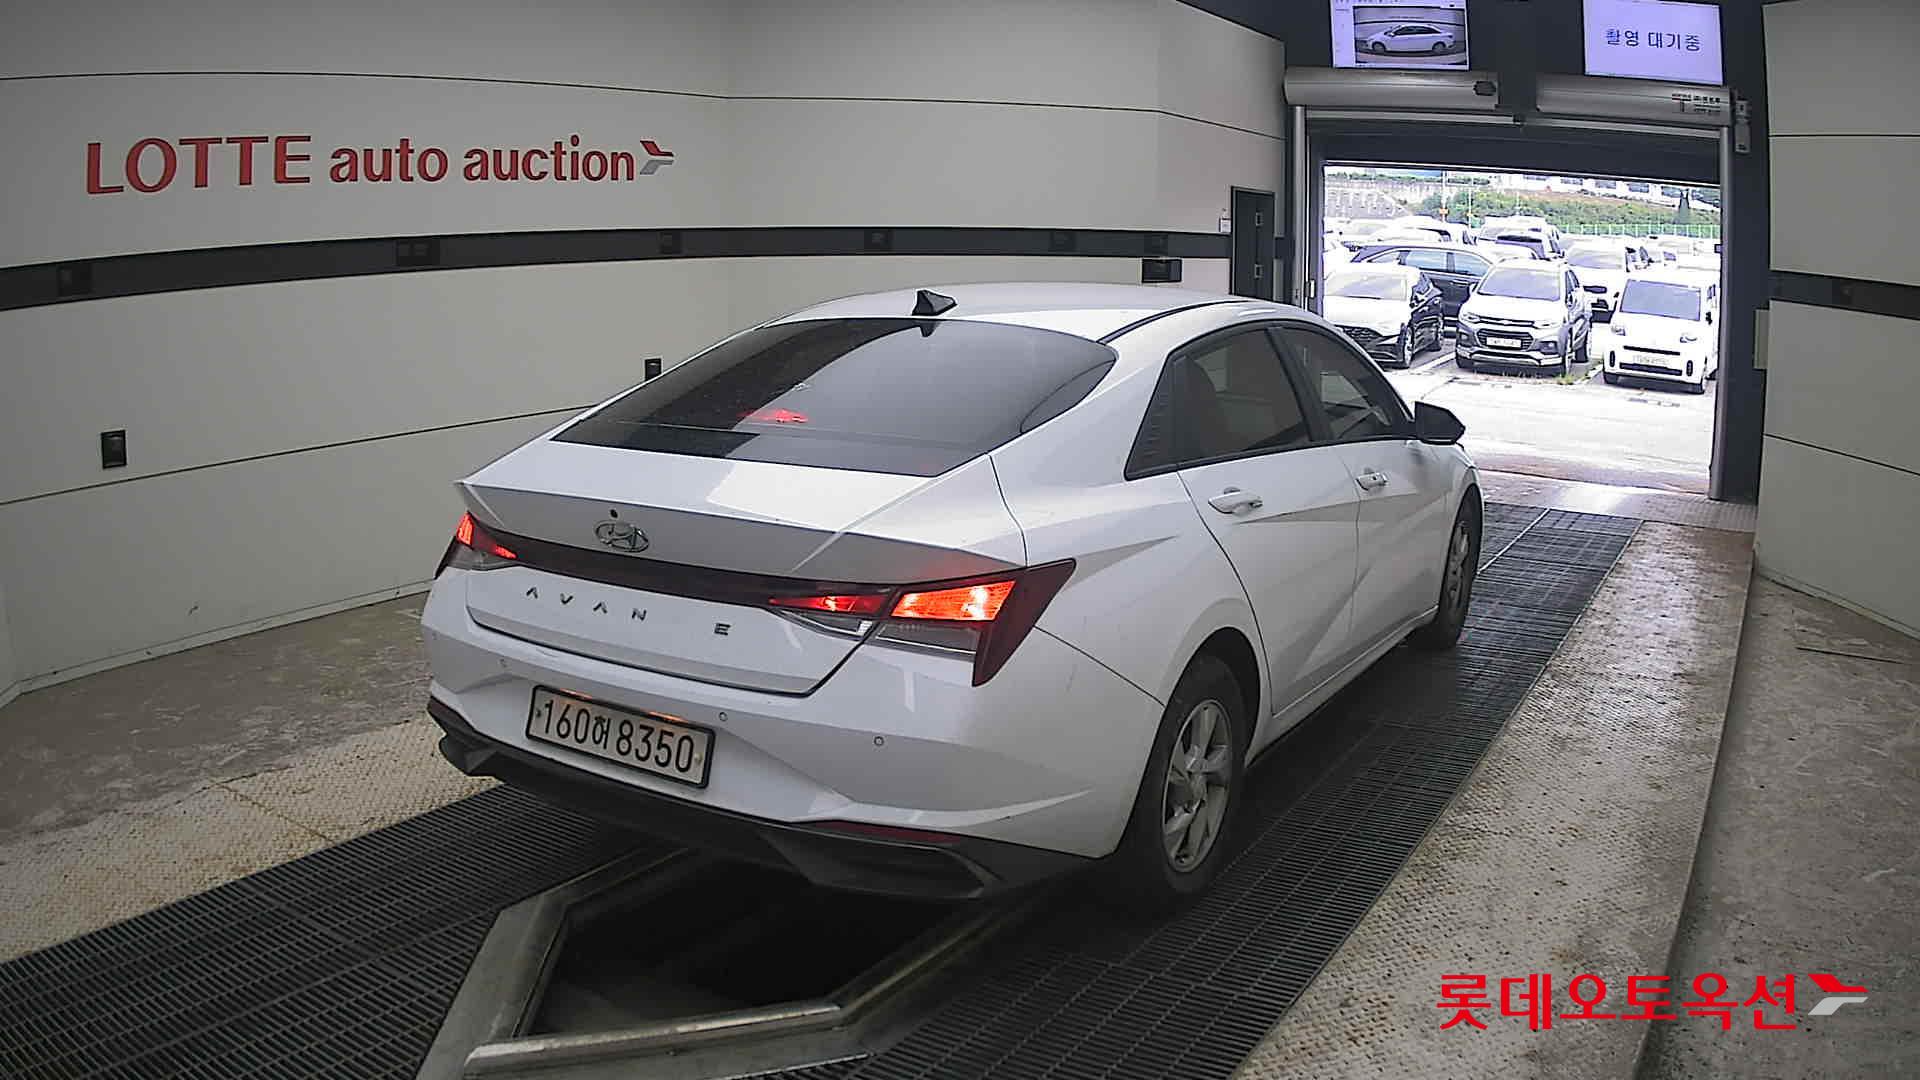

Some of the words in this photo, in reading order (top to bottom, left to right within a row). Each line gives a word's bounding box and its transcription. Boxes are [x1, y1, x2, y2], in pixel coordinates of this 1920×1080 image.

[1606, 28, 1640, 48] 촬영
[1647, 31, 1701, 52] 대기중
[86, 135, 311, 195] LOTTE
[330, 138, 449, 183] auto
[463, 134, 635, 182] auction
